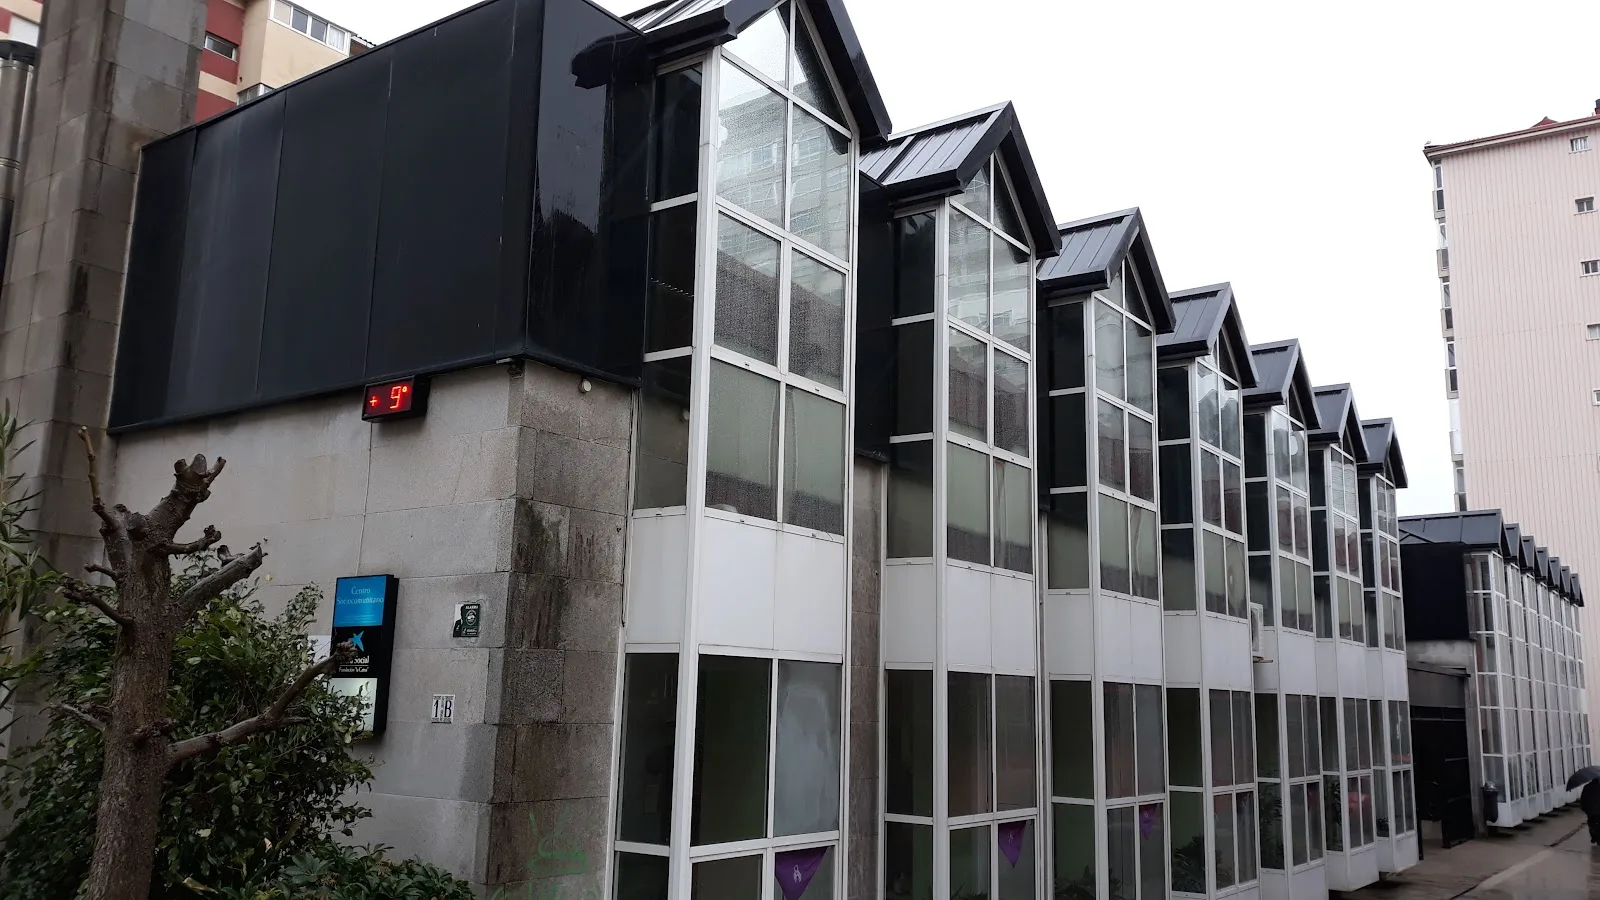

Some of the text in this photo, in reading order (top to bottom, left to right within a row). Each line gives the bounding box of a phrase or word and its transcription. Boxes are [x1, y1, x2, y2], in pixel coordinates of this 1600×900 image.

[351, 586, 371, 595] Centro
[354, 654, 370, 664] Social
[433, 699, 452, 718] 1 B
